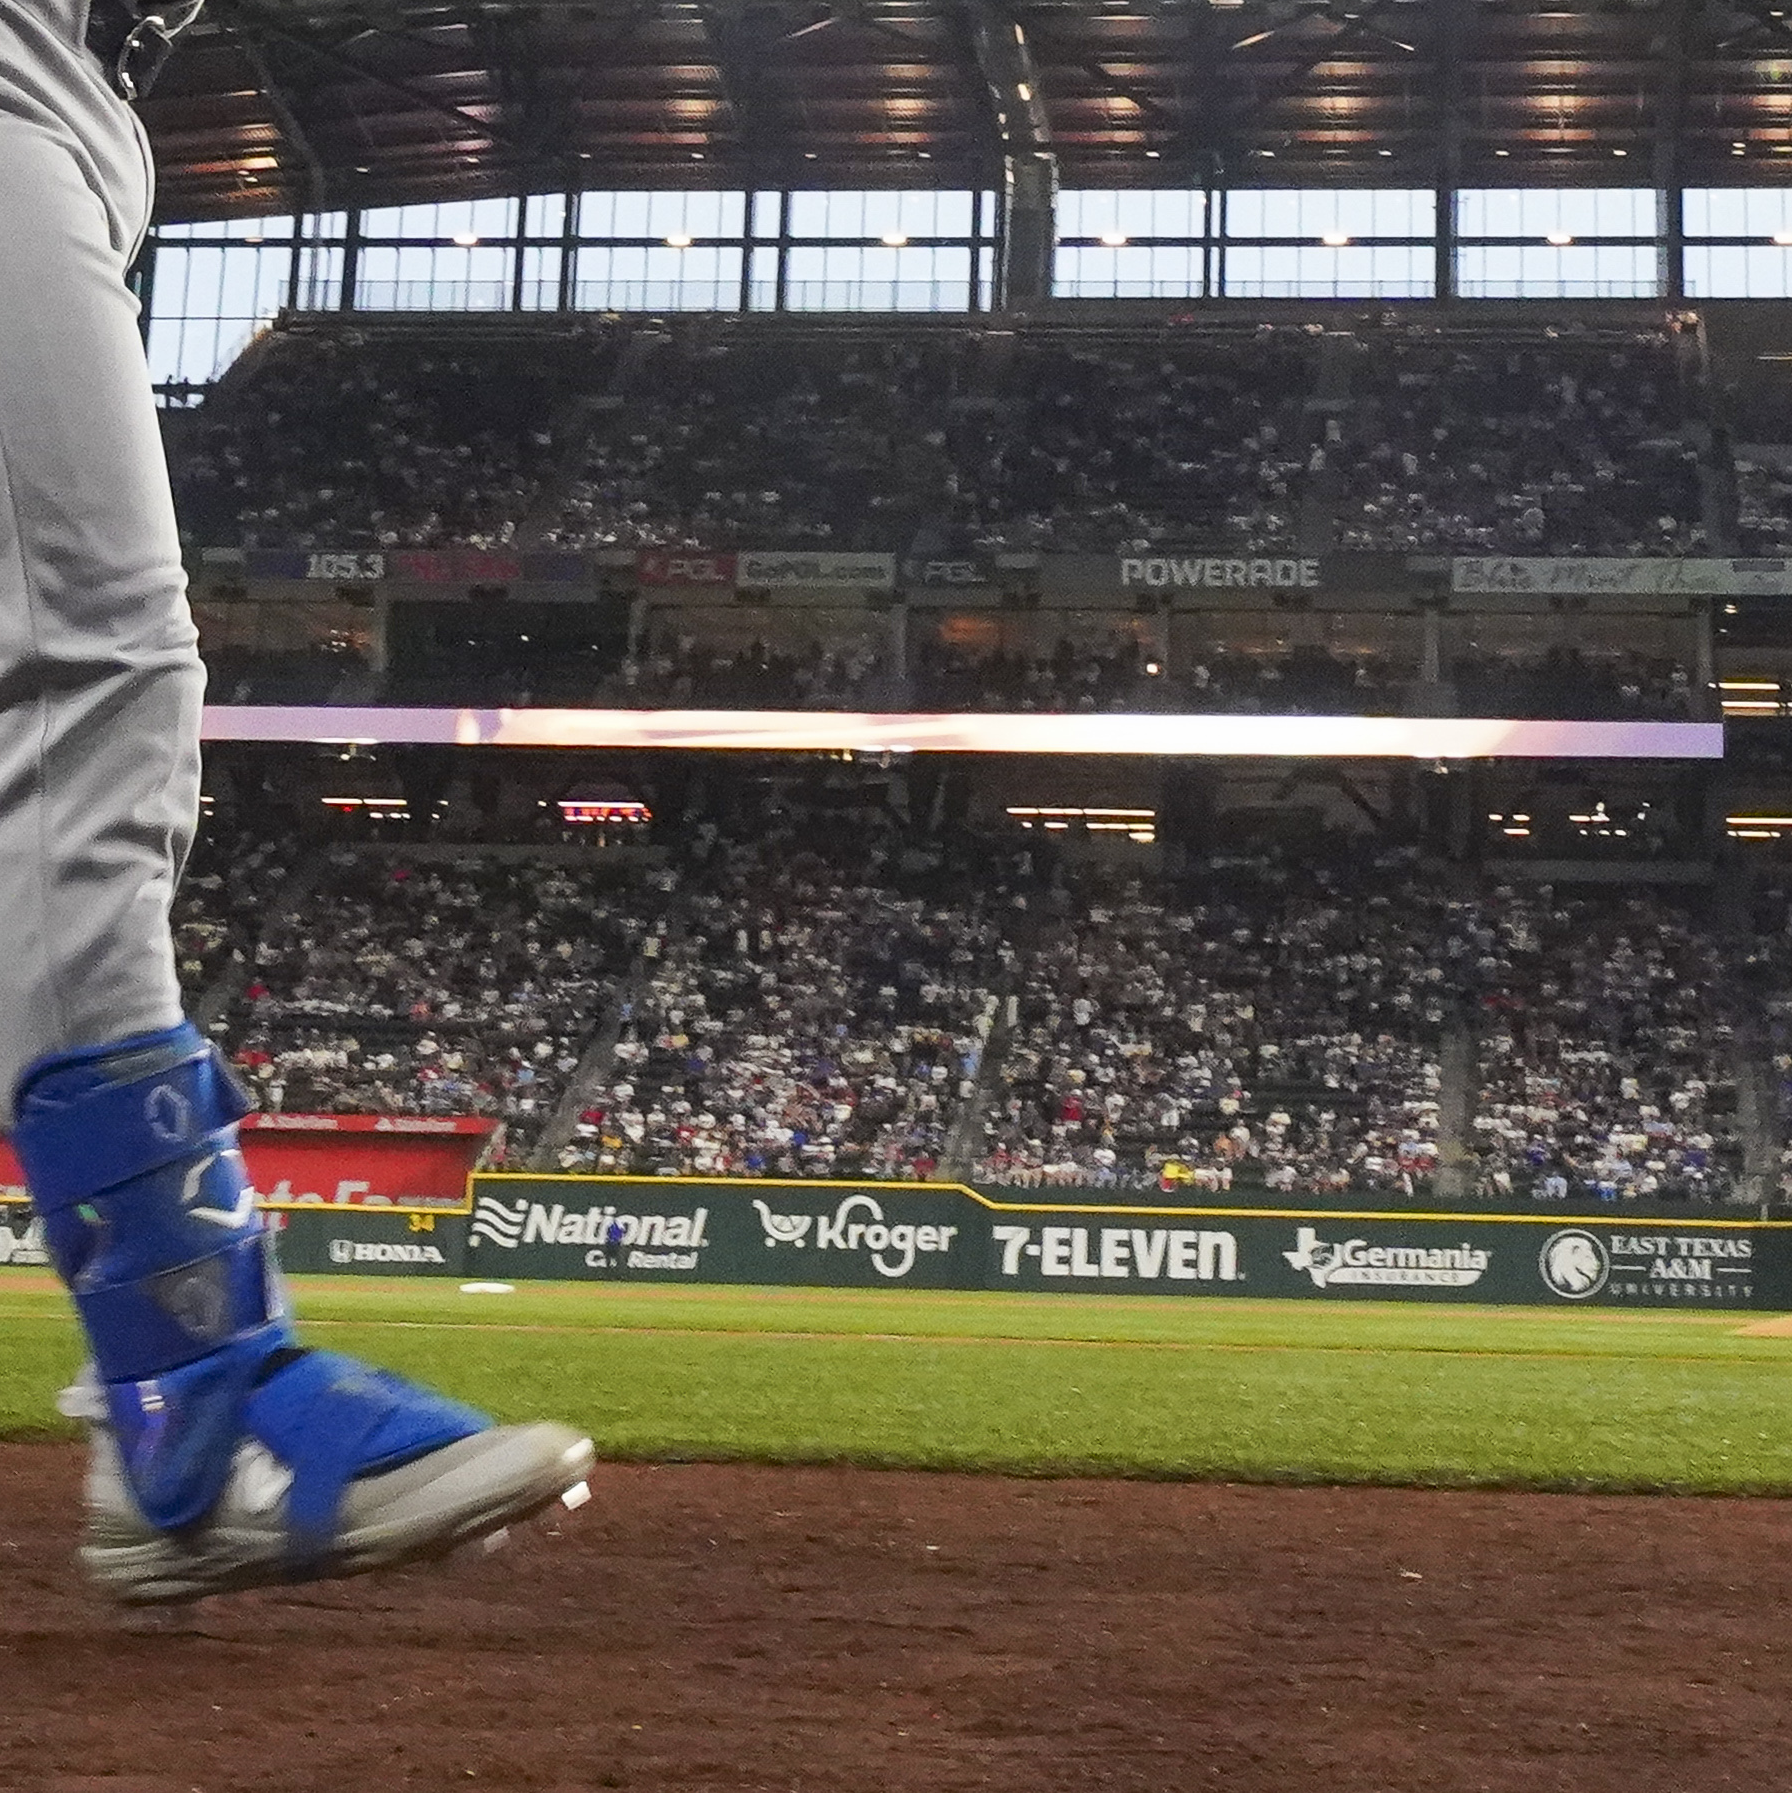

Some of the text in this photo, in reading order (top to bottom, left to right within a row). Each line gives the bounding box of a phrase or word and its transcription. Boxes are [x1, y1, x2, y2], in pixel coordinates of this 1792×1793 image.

[307, 553, 385, 580] 105.3
[1122, 558, 1321, 587] POWERADE
[522, 1203, 704, 1247] National
[816, 1194, 959, 1278] Kroger
[354, 1243, 446, 1263] HONDA
[1344, 1239, 1489, 1270] Germania
[1610, 1234, 1753, 1258] EAST TEXAS
[1649, 1258, 1713, 1280] A&M
[1609, 1282, 1754, 1298] UNIVERSITY
